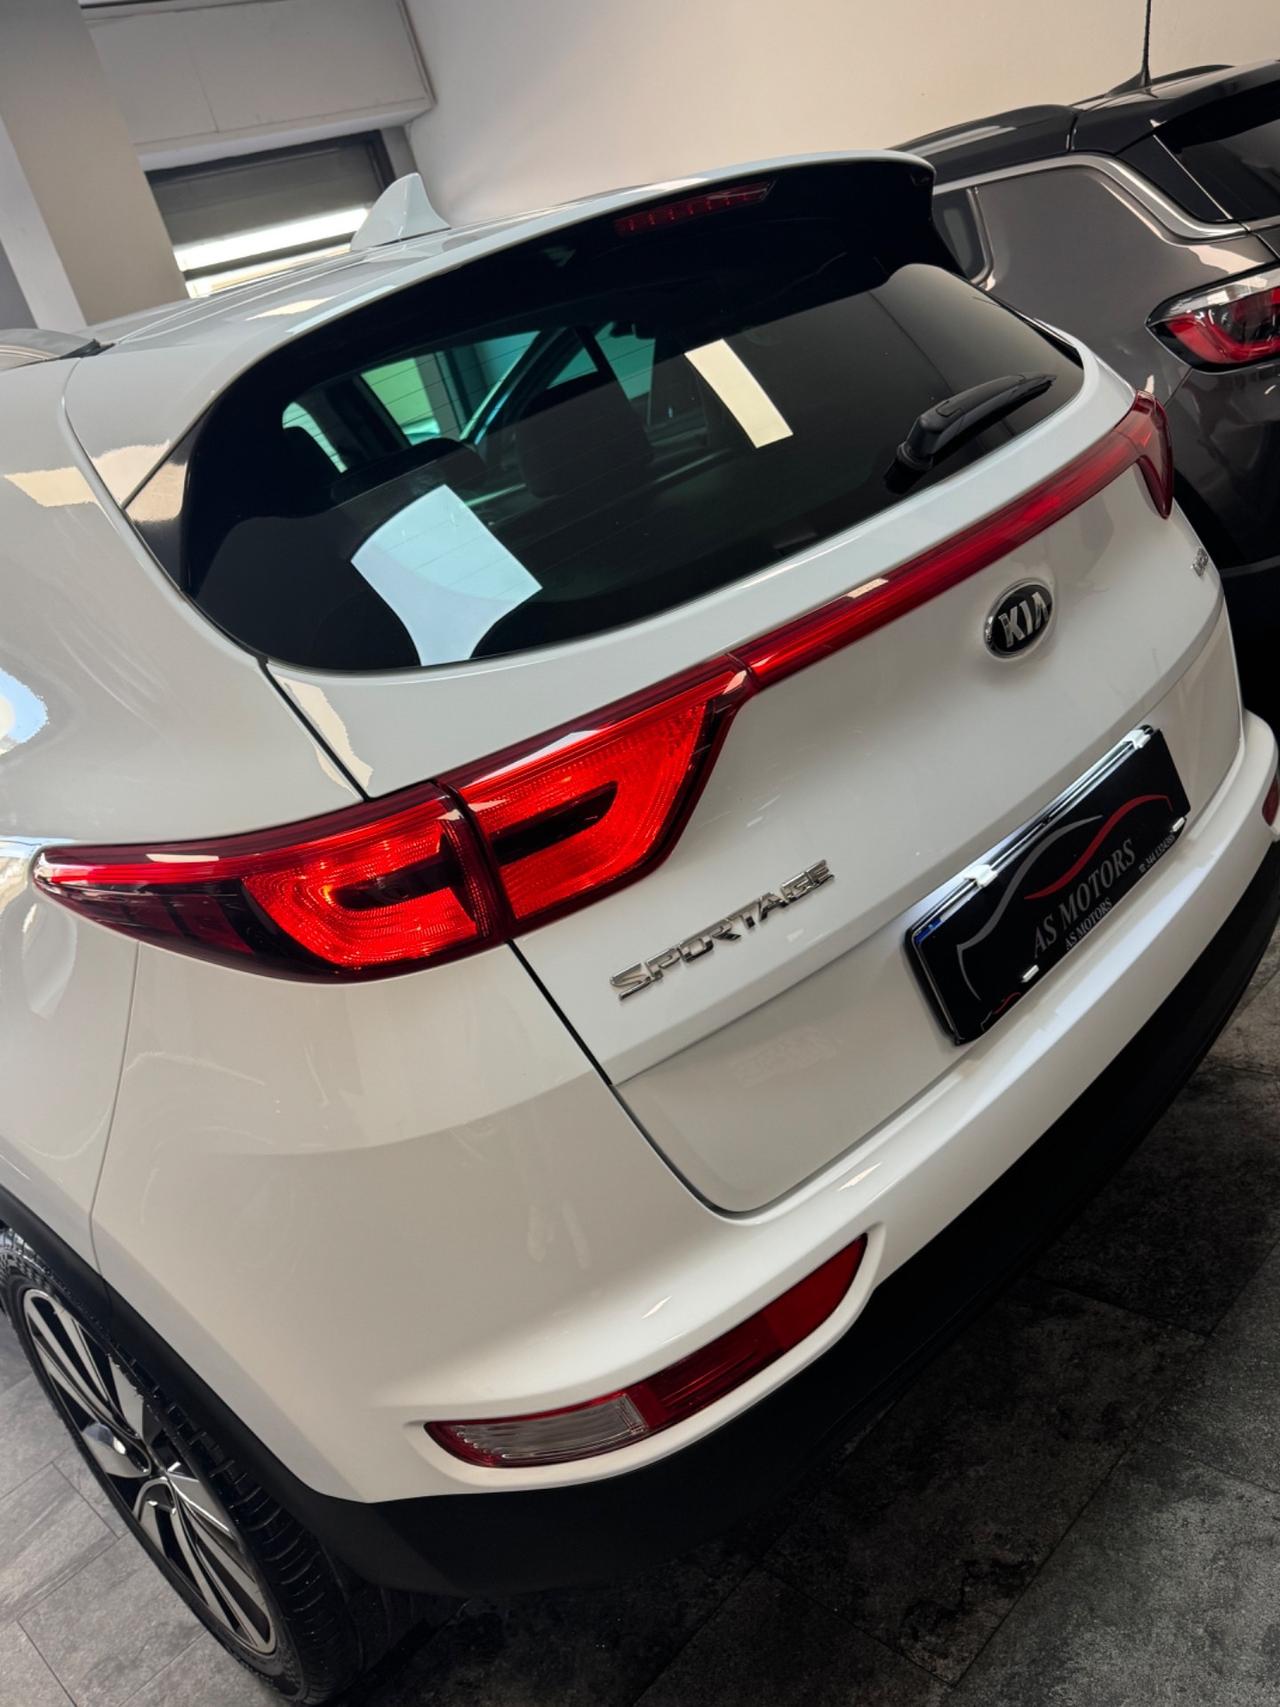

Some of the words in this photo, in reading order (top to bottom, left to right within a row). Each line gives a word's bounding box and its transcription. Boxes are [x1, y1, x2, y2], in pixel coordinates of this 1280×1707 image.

[998, 591, 1050, 649] KIA
[609, 858, 835, 1001] SPORTAGE
[1034, 913, 1058, 959] AS
[1058, 838, 1136, 931] MOTORS
[1064, 931, 1078, 951] AS
[1075, 896, 1113, 939] MOTORS
